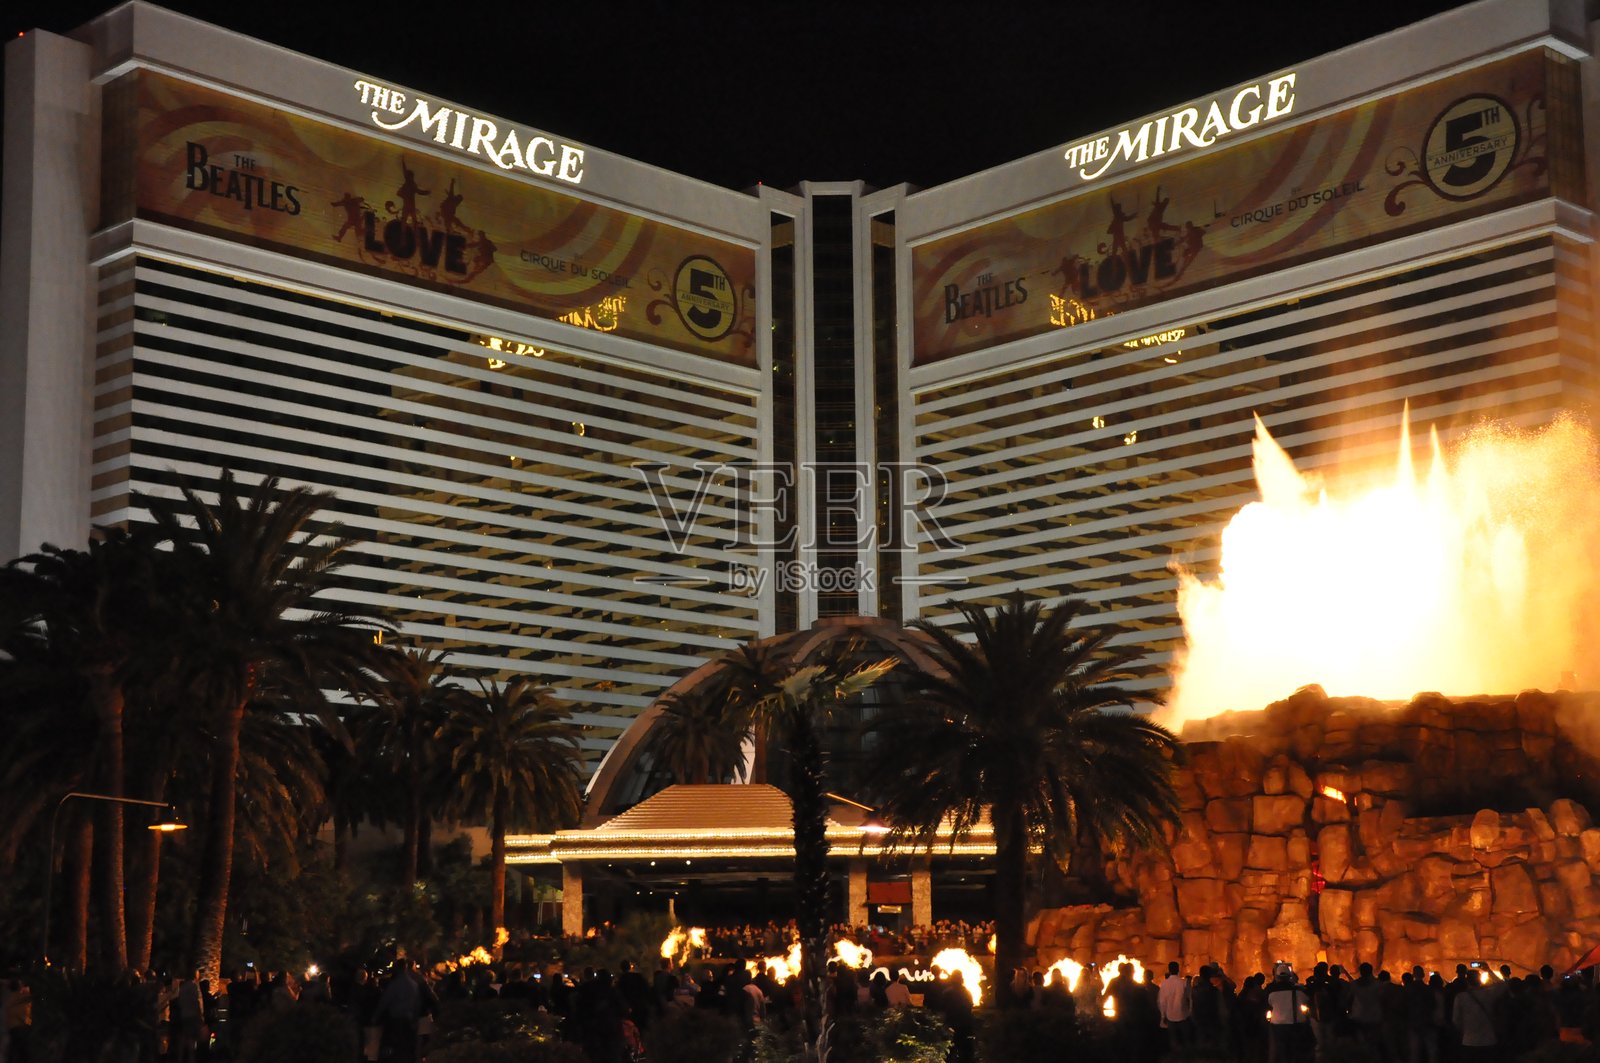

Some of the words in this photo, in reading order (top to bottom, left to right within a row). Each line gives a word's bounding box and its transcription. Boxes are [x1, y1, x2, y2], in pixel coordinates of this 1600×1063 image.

[354, 80, 406, 114] THE
[371, 99, 585, 184] MIRAGE
[1080, 73, 1296, 180] MIRAGE
[234, 154, 256, 169] THE
[1064, 136, 1109, 168] THE
[1433, 136, 1508, 166] ANNIVERSARY
[186, 141, 300, 216] BEATLES
[1231, 203, 1284, 228] CIRQUE
[1288, 197, 1308, 212] DU
[1312, 181, 1365, 205] SOLEIL
[363, 211, 468, 275] LOVE
[520, 249, 566, 274] CIRQUE
[570, 262, 588, 277] DU
[591, 269, 632, 289] SOLEIL
[976, 272, 993, 285] THE
[1079, 237, 1176, 300] LOVE
[944, 277, 1028, 324] BEATLES
